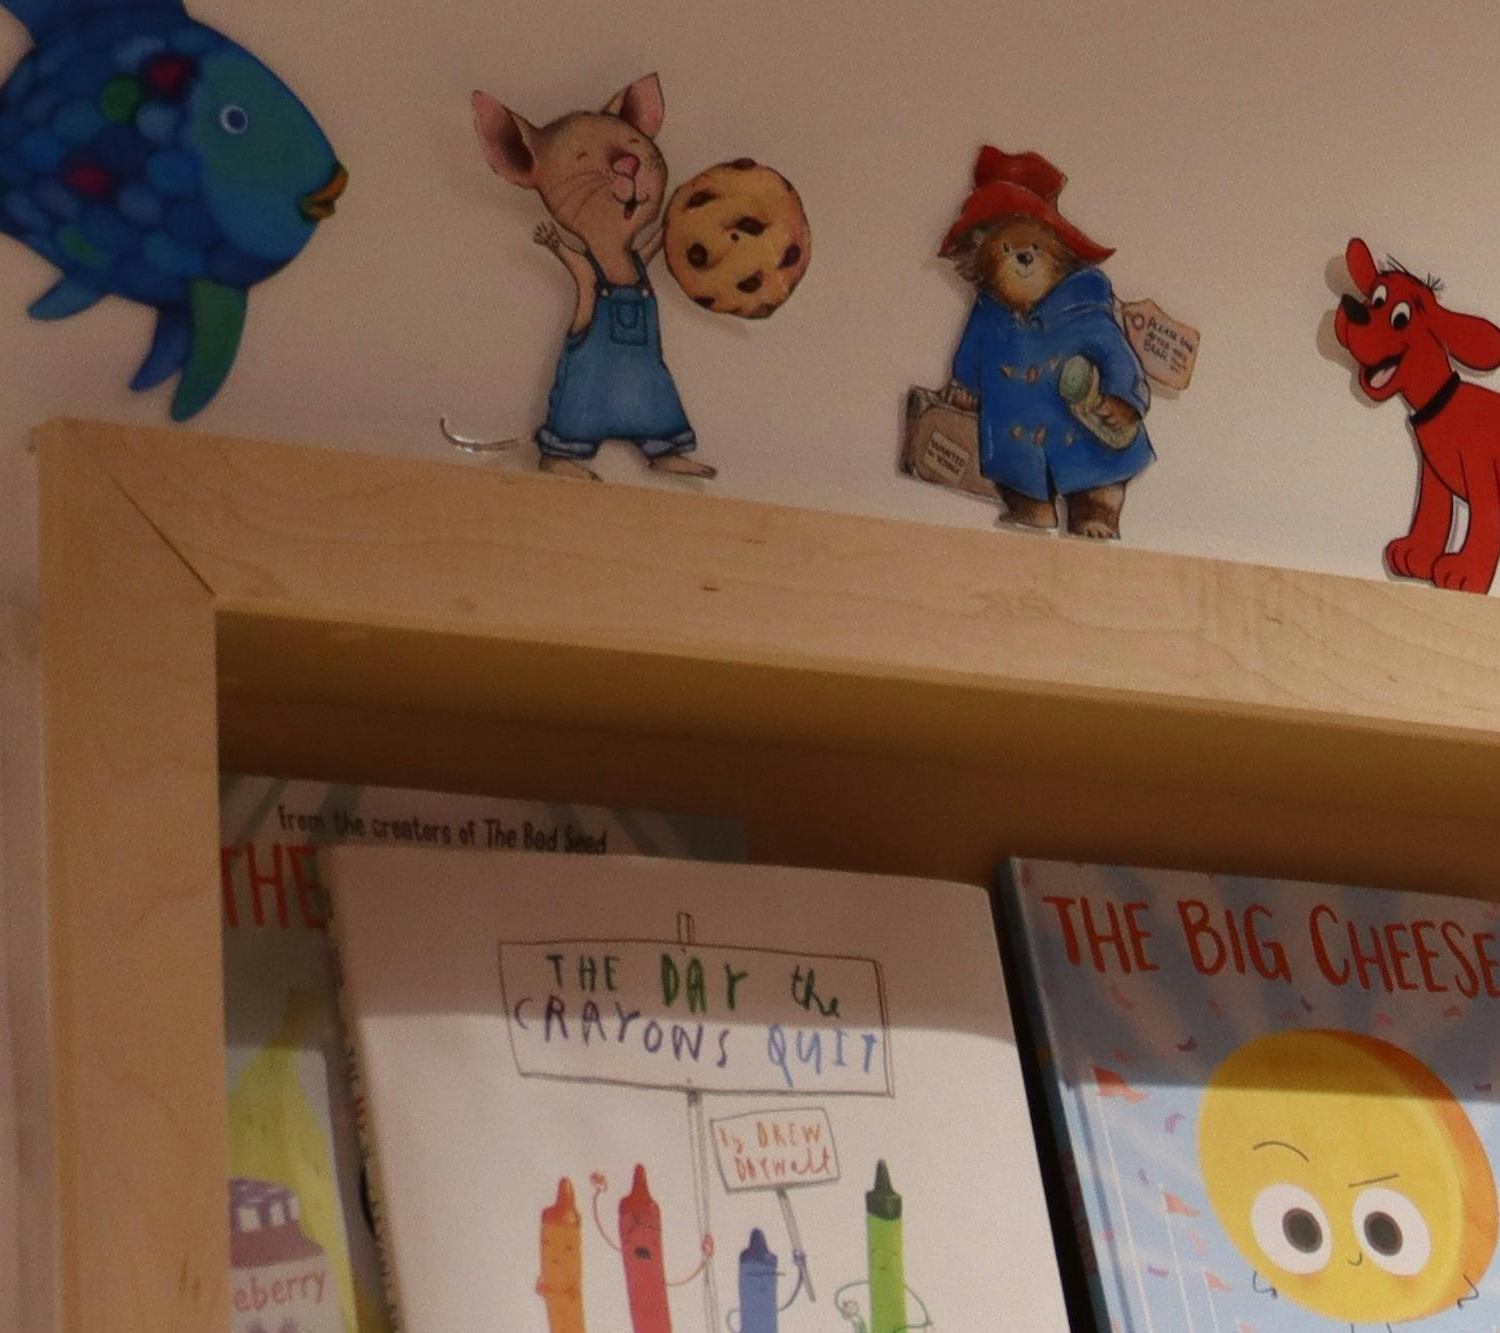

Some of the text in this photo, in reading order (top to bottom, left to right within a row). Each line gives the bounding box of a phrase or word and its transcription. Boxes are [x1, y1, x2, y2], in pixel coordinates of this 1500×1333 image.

[333, 812, 366, 838] the
[371, 817, 453, 845] creators
[459, 818, 477, 846] of
[483, 820, 518, 849] The
[522, 821, 560, 852] Bad
[220, 841, 328, 931] THE
[1042, 895, 1161, 976] THE
[1177, 898, 1296, 984] BIG
[545, 953, 842, 1018] THE DAY the
[512, 996, 879, 1089] CRAYONS QUIT
